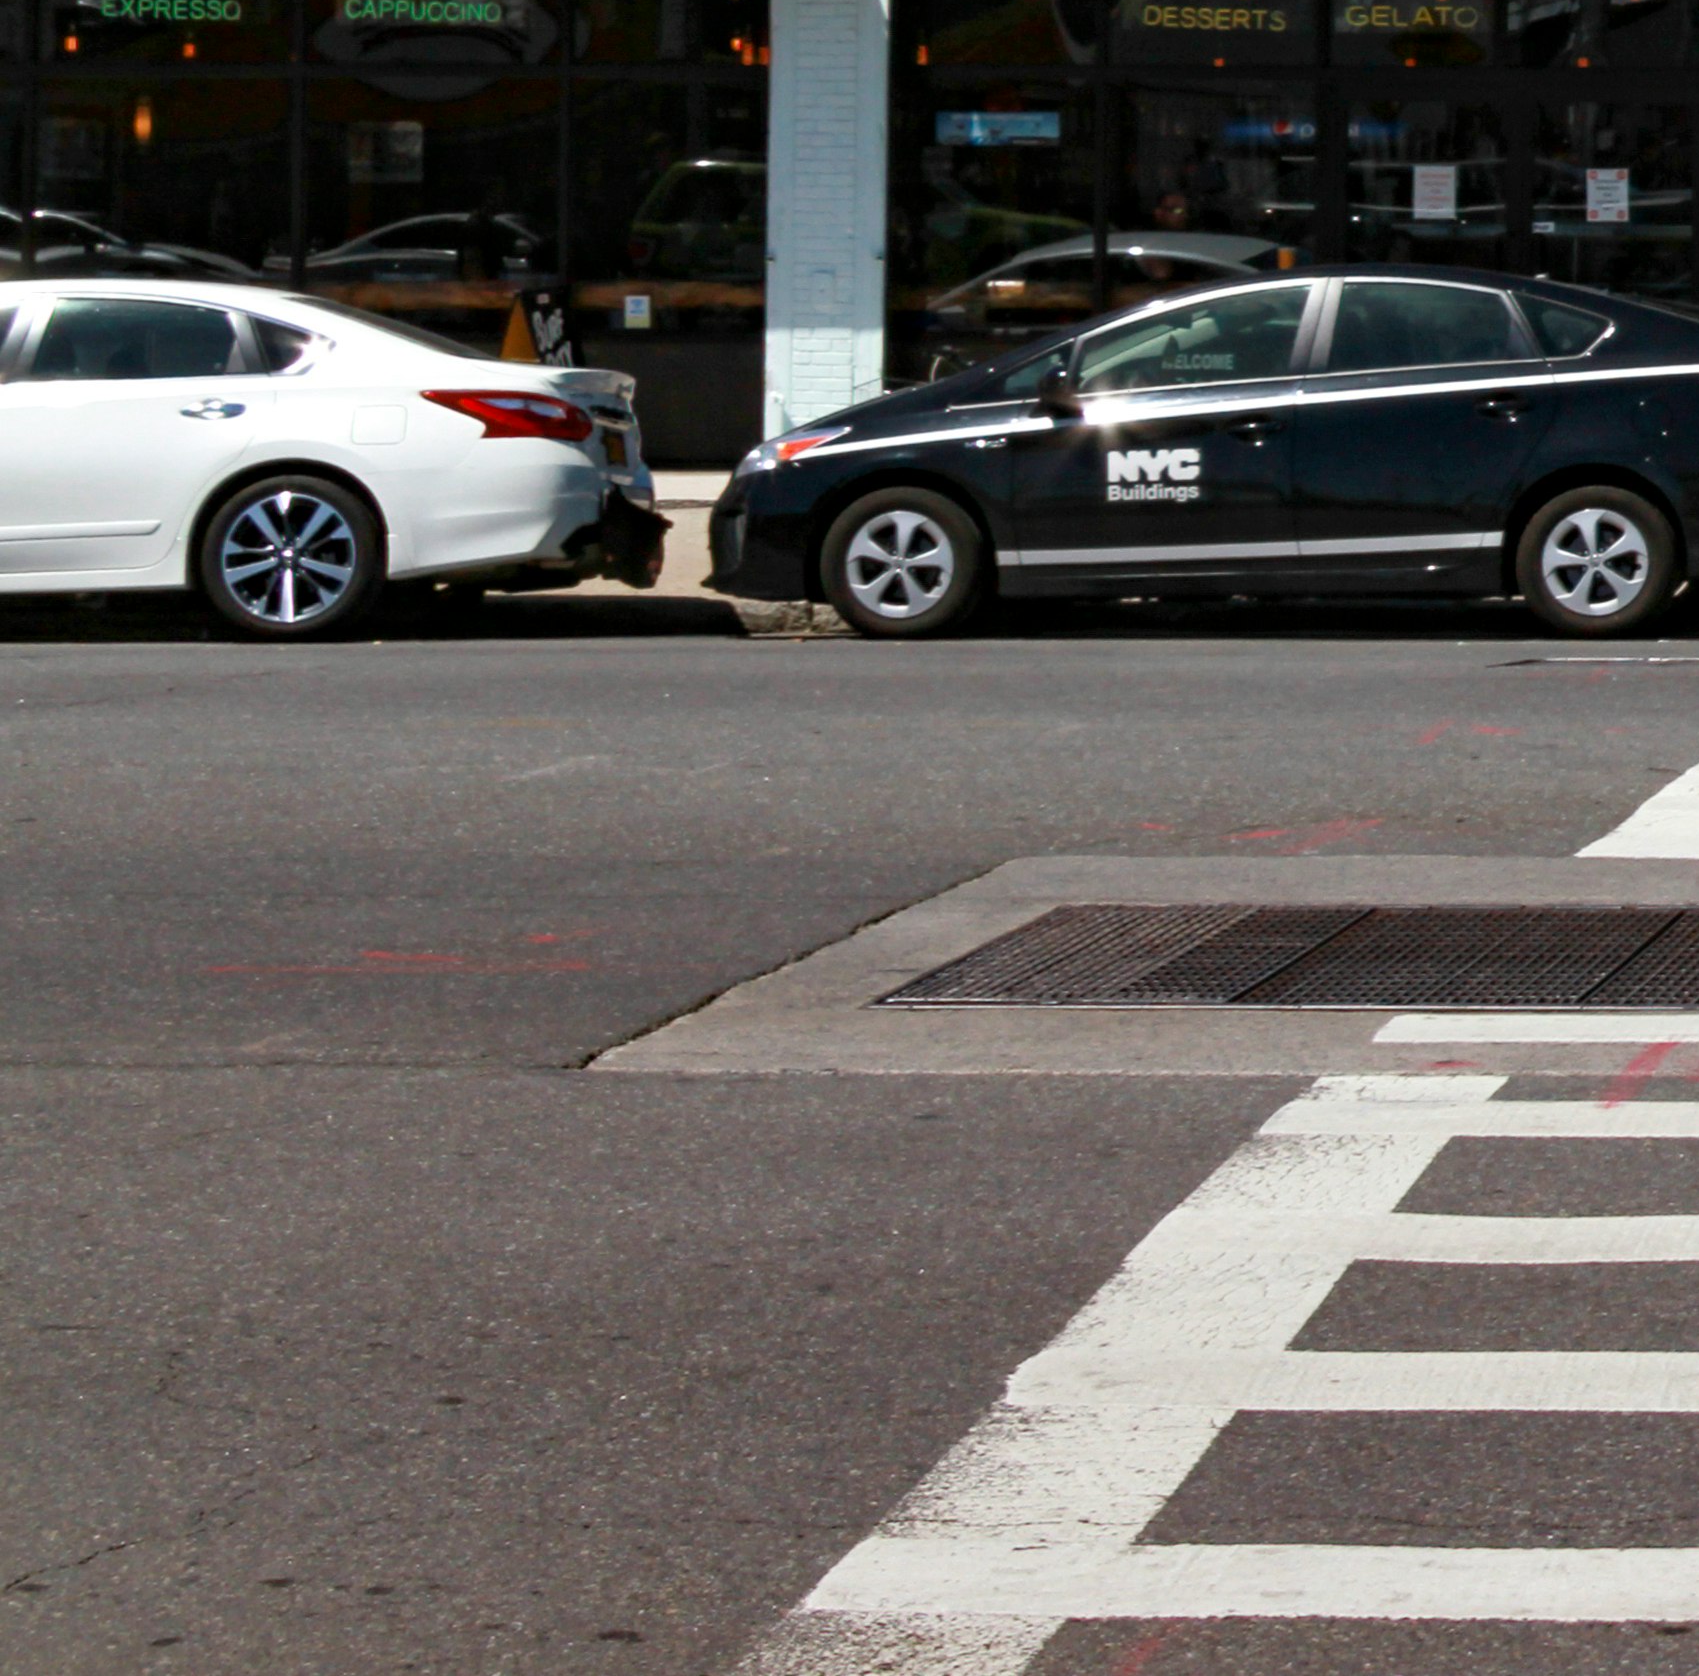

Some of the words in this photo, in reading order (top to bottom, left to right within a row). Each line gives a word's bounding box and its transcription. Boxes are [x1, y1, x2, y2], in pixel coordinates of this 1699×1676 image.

[1143, 4, 1287, 32] DESSERTS
[1344, 5, 1480, 28] GELATO
[1107, 448, 1201, 483] NYC
[1107, 483, 1200, 503] Buildings
